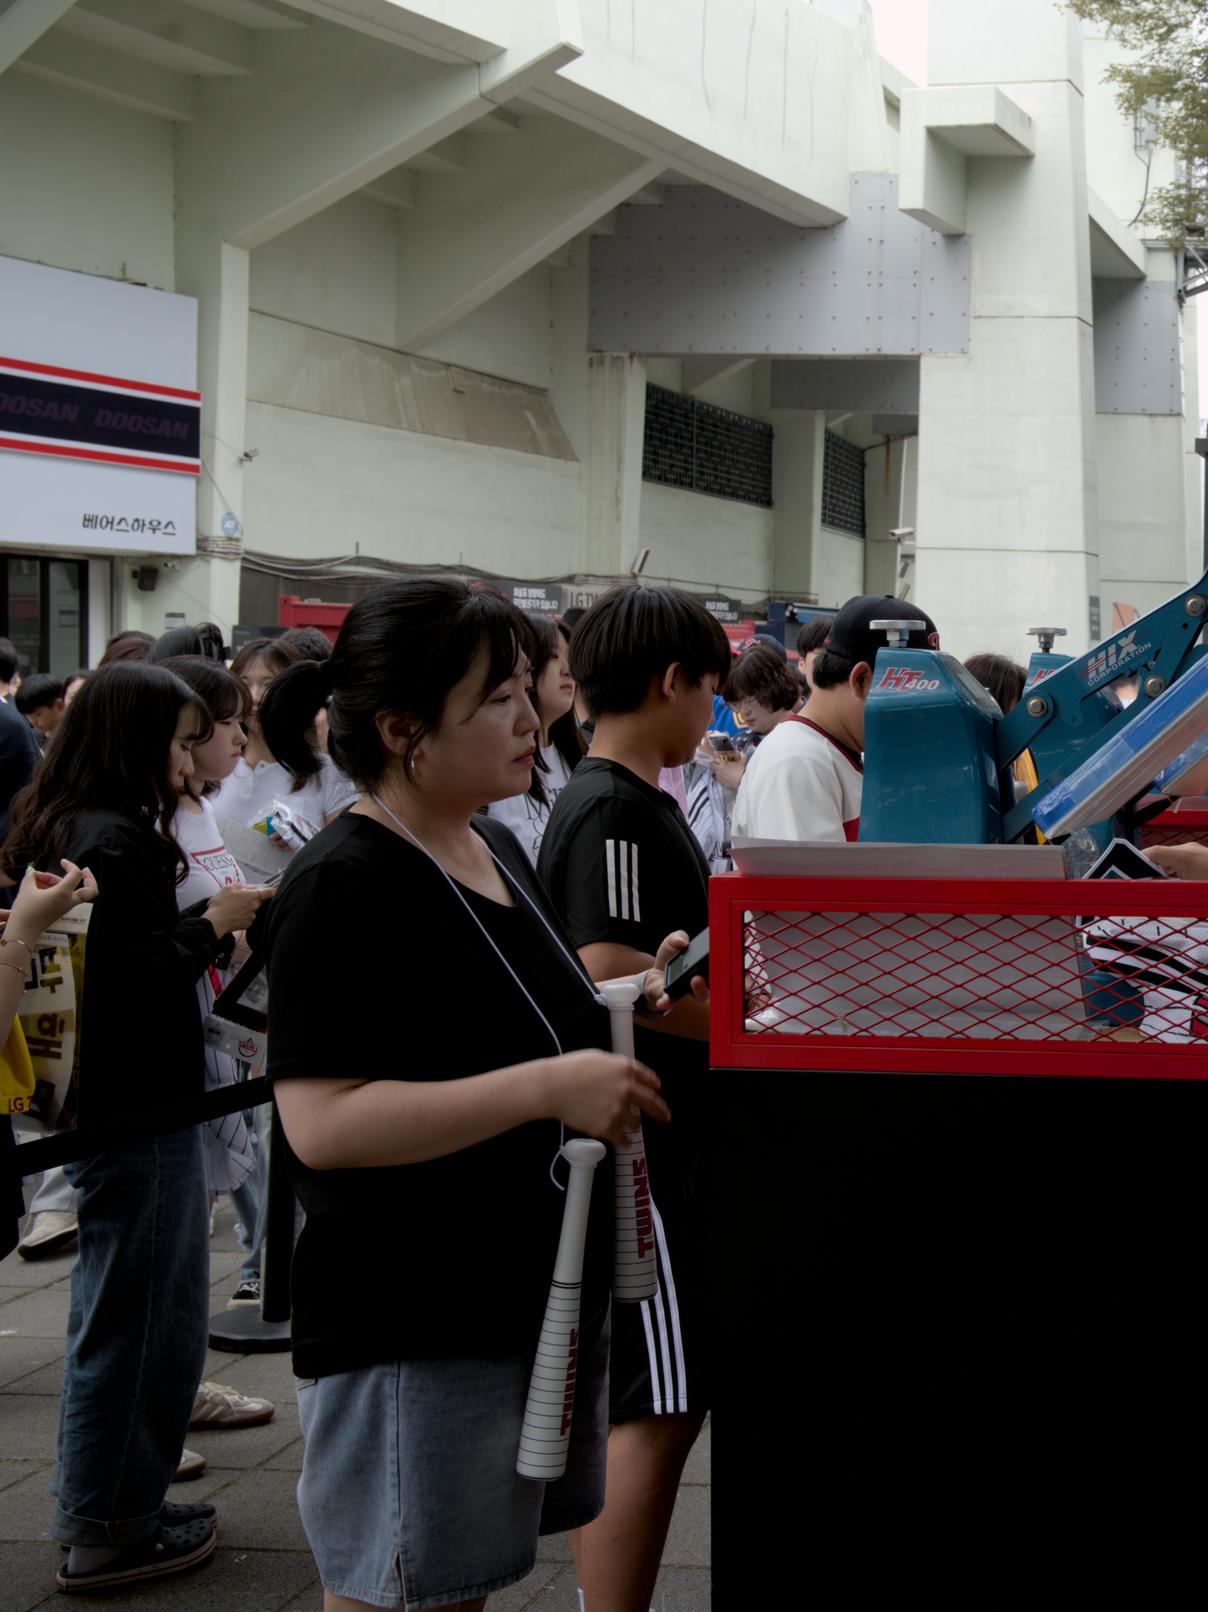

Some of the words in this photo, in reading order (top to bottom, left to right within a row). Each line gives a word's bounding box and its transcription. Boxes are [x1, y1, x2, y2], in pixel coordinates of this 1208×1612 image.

[0, 392, 80, 423] OOSAN
[93, 407, 191, 439] DOOSAN
[82, 513, 176, 537] 베어스하우스
[1087, 630, 1137, 680] HIX
[1087, 641, 1152, 687] CORPORATION
[8, 1097, 24, 1113] LG
[632, 1157, 654, 1259] TWINS
